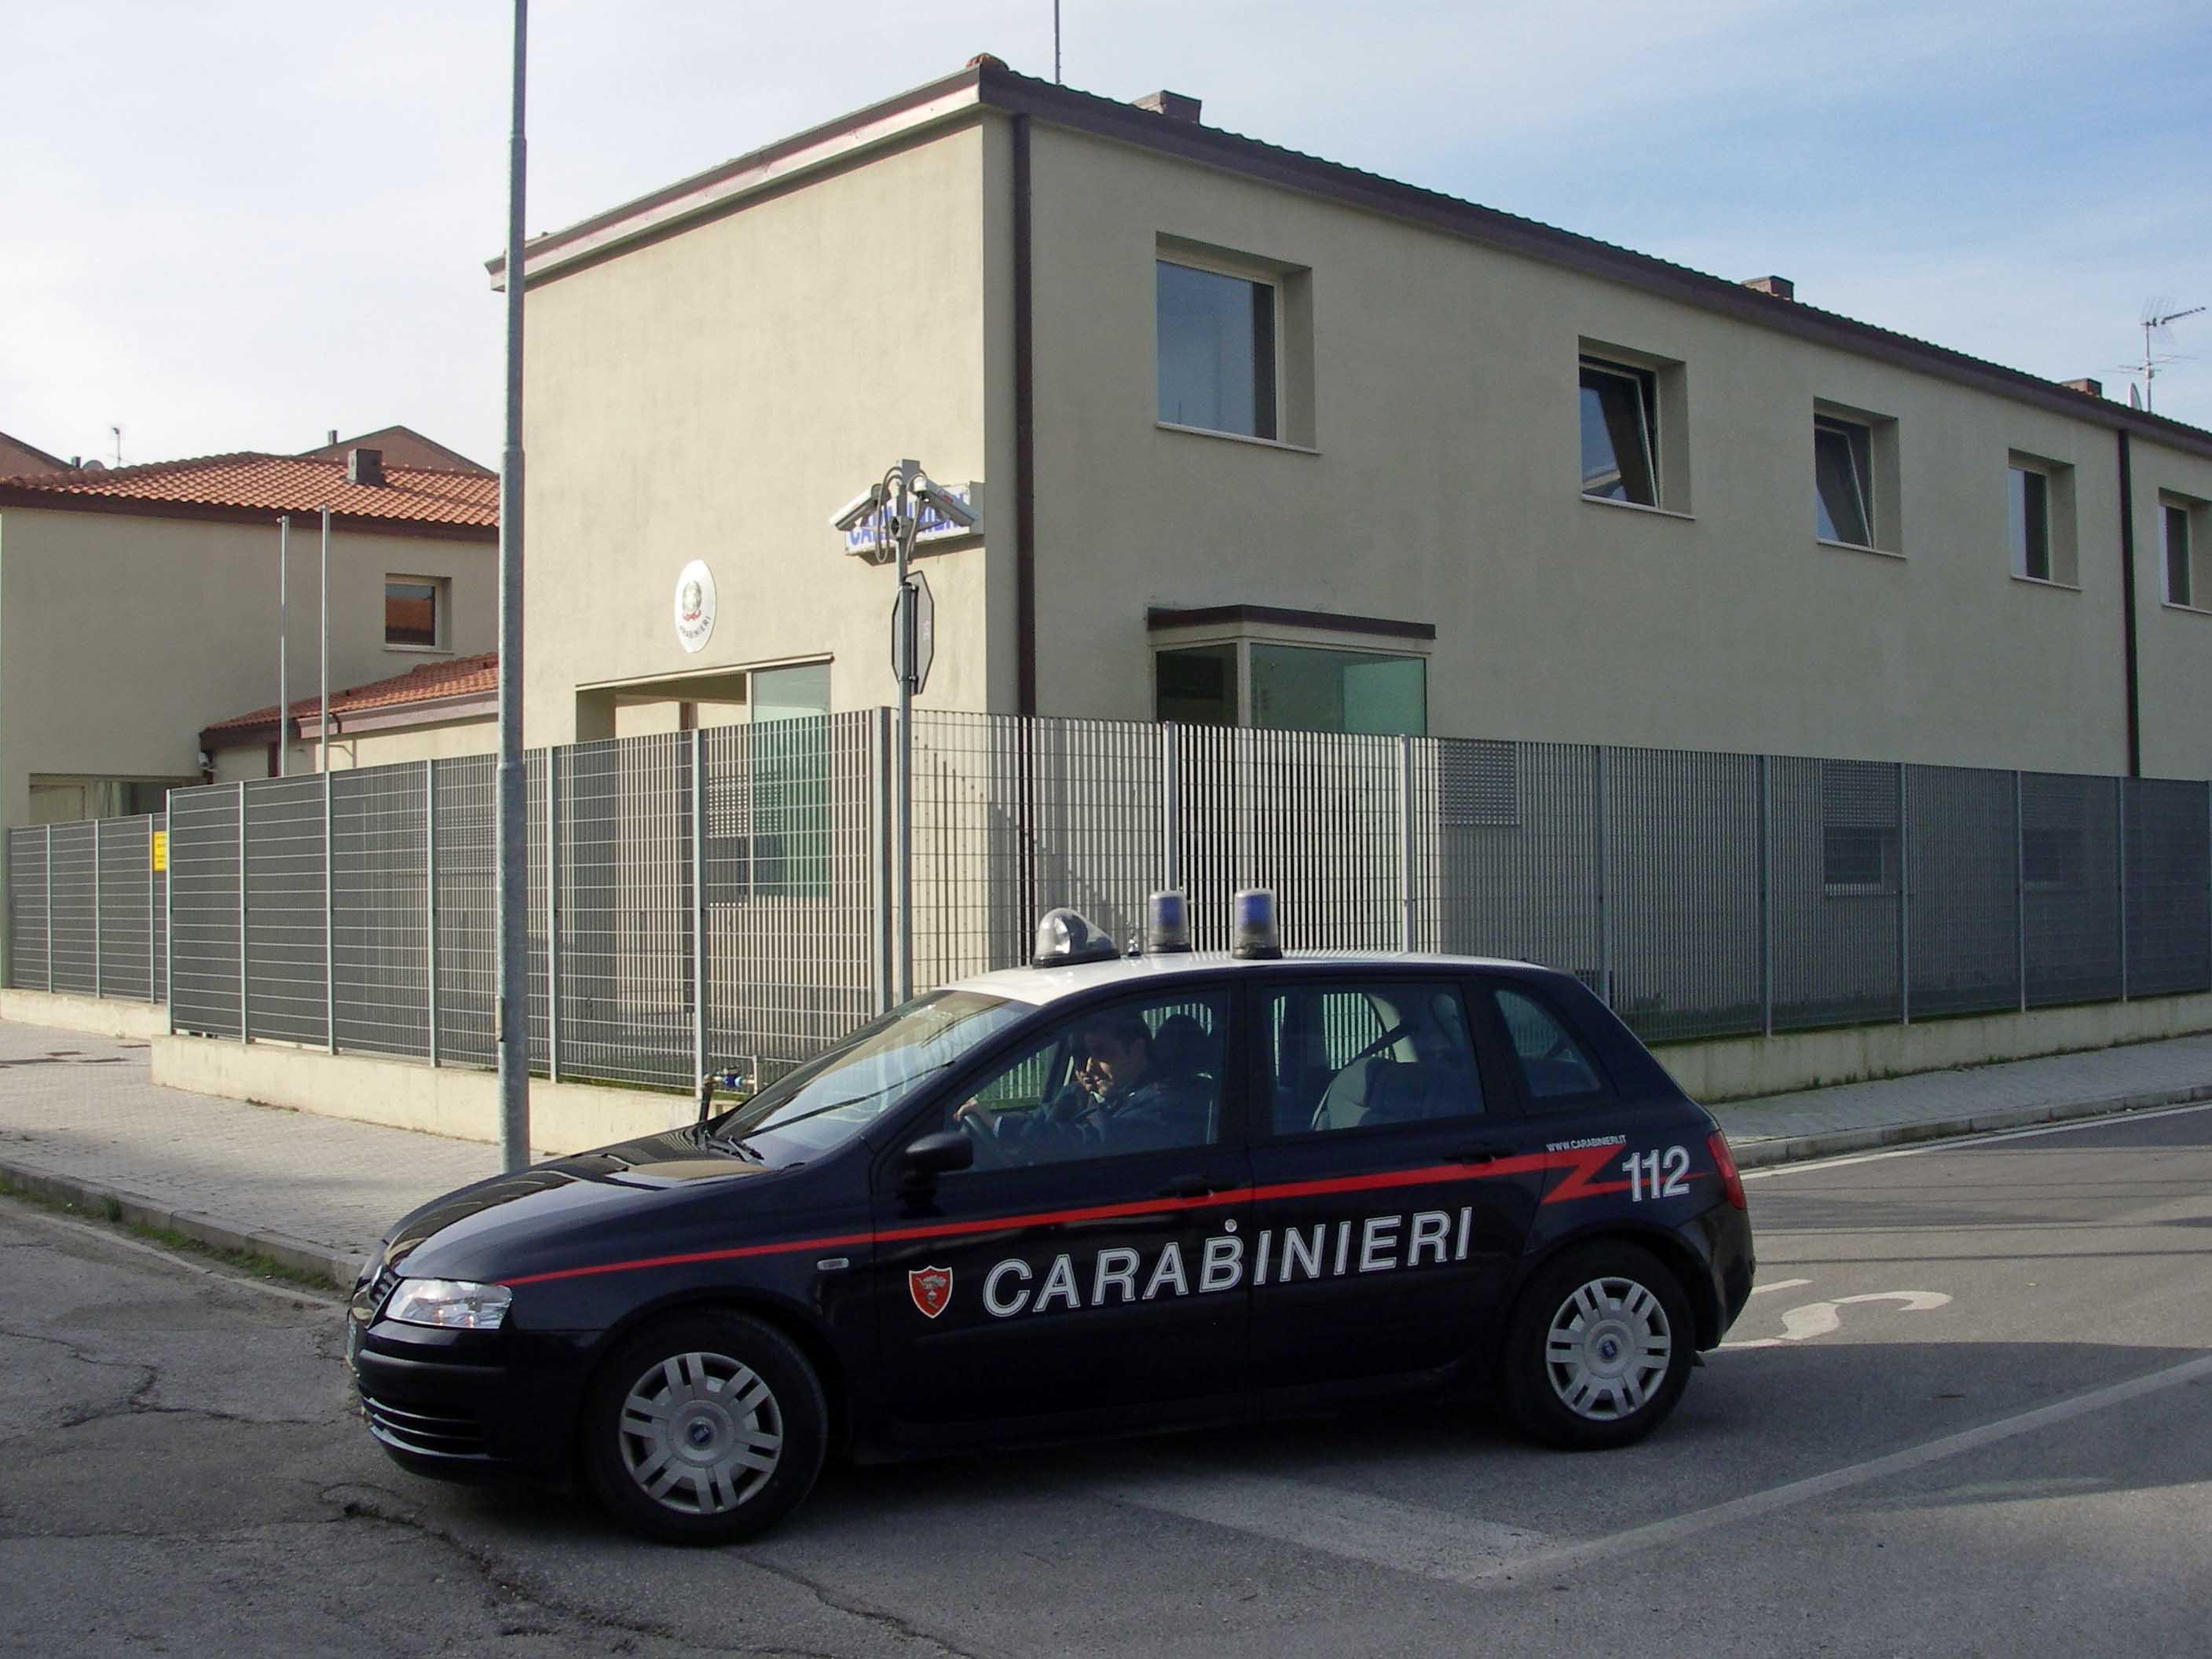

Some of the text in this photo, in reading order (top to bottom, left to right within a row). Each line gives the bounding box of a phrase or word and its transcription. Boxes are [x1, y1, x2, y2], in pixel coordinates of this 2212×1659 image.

[1546, 1134, 1627, 1152] WWW.CARABINIERI.IT
[1621, 1144, 1691, 1203] 112
[983, 1207, 1472, 1317] CARABINIERI
